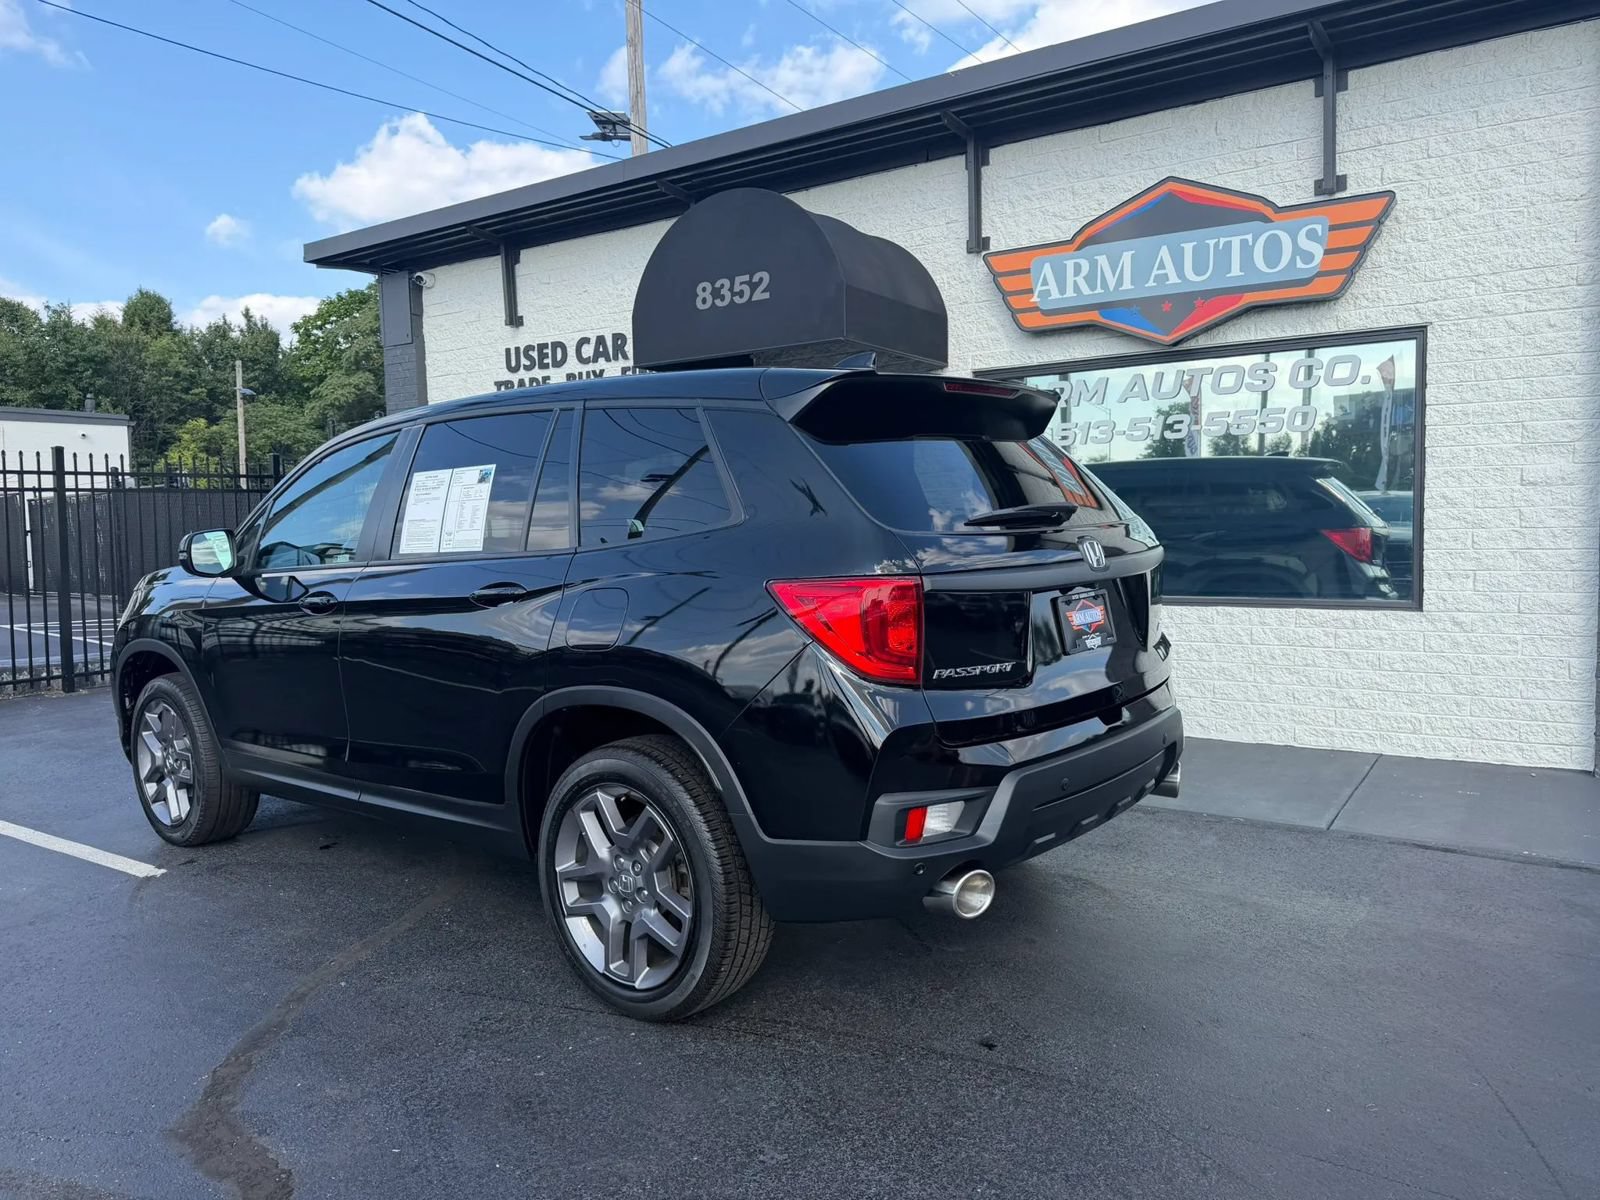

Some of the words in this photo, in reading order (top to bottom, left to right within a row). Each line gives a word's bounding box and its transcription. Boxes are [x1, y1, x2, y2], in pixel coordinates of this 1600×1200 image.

[1029, 250, 1136, 302] ARM
[1144, 223, 1325, 287] AUTOS
[695, 271, 771, 310] 8352
[505, 340, 568, 374] USED
[1046, 376, 1109, 408] RM
[1116, 361, 1278, 404] AUTOS
[1288, 353, 1372, 391] CO.
[1054, 404, 1318, 447] 513-513-5550
[932, 661, 1017, 680] PASSPORT
